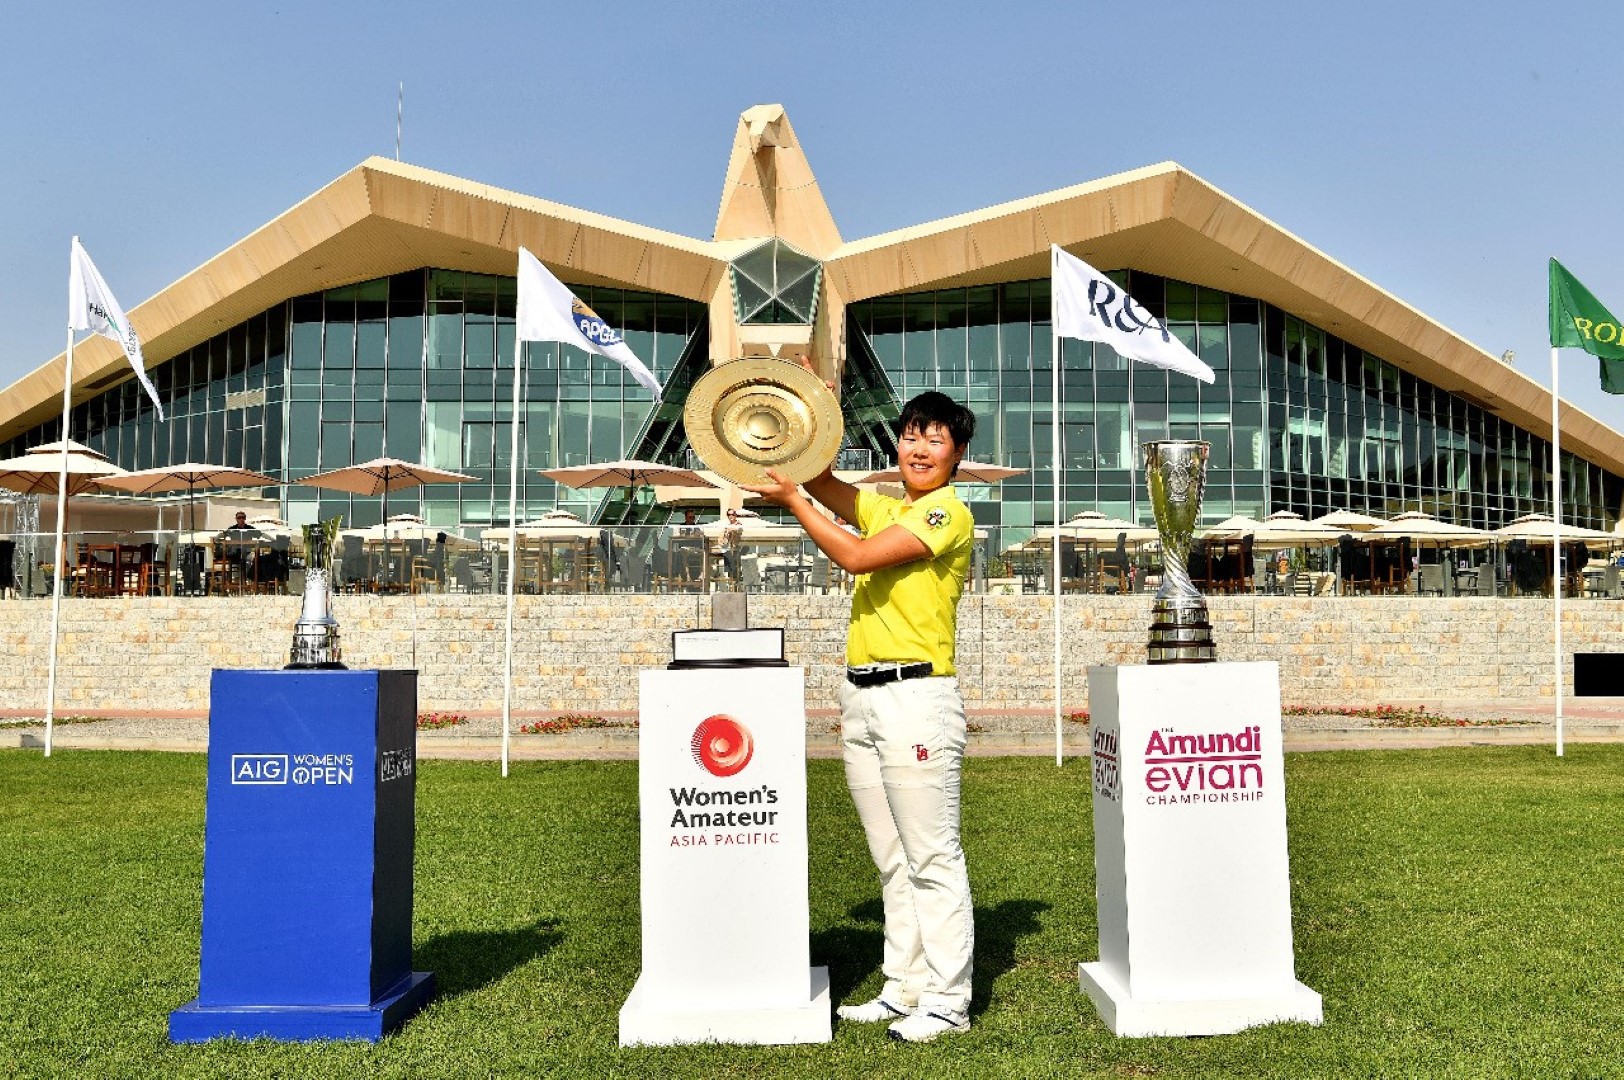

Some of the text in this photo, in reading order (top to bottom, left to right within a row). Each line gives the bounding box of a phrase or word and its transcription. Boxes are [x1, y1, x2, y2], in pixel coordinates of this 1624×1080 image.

[1088, 279, 1170, 343] R&A
[1145, 725, 1262, 755] Amundi
[238, 760, 281, 778] AIG
[294, 755, 354, 766] WOMEN'S
[292, 767, 354, 785] OPEN
[1145, 763, 1263, 792] evian
[669, 785, 778, 806] Women's
[1146, 791, 1263, 805] CHAMPIONSHIP
[670, 808, 778, 828] Amateur
[671, 833, 779, 847] ASIA PACIFIC
